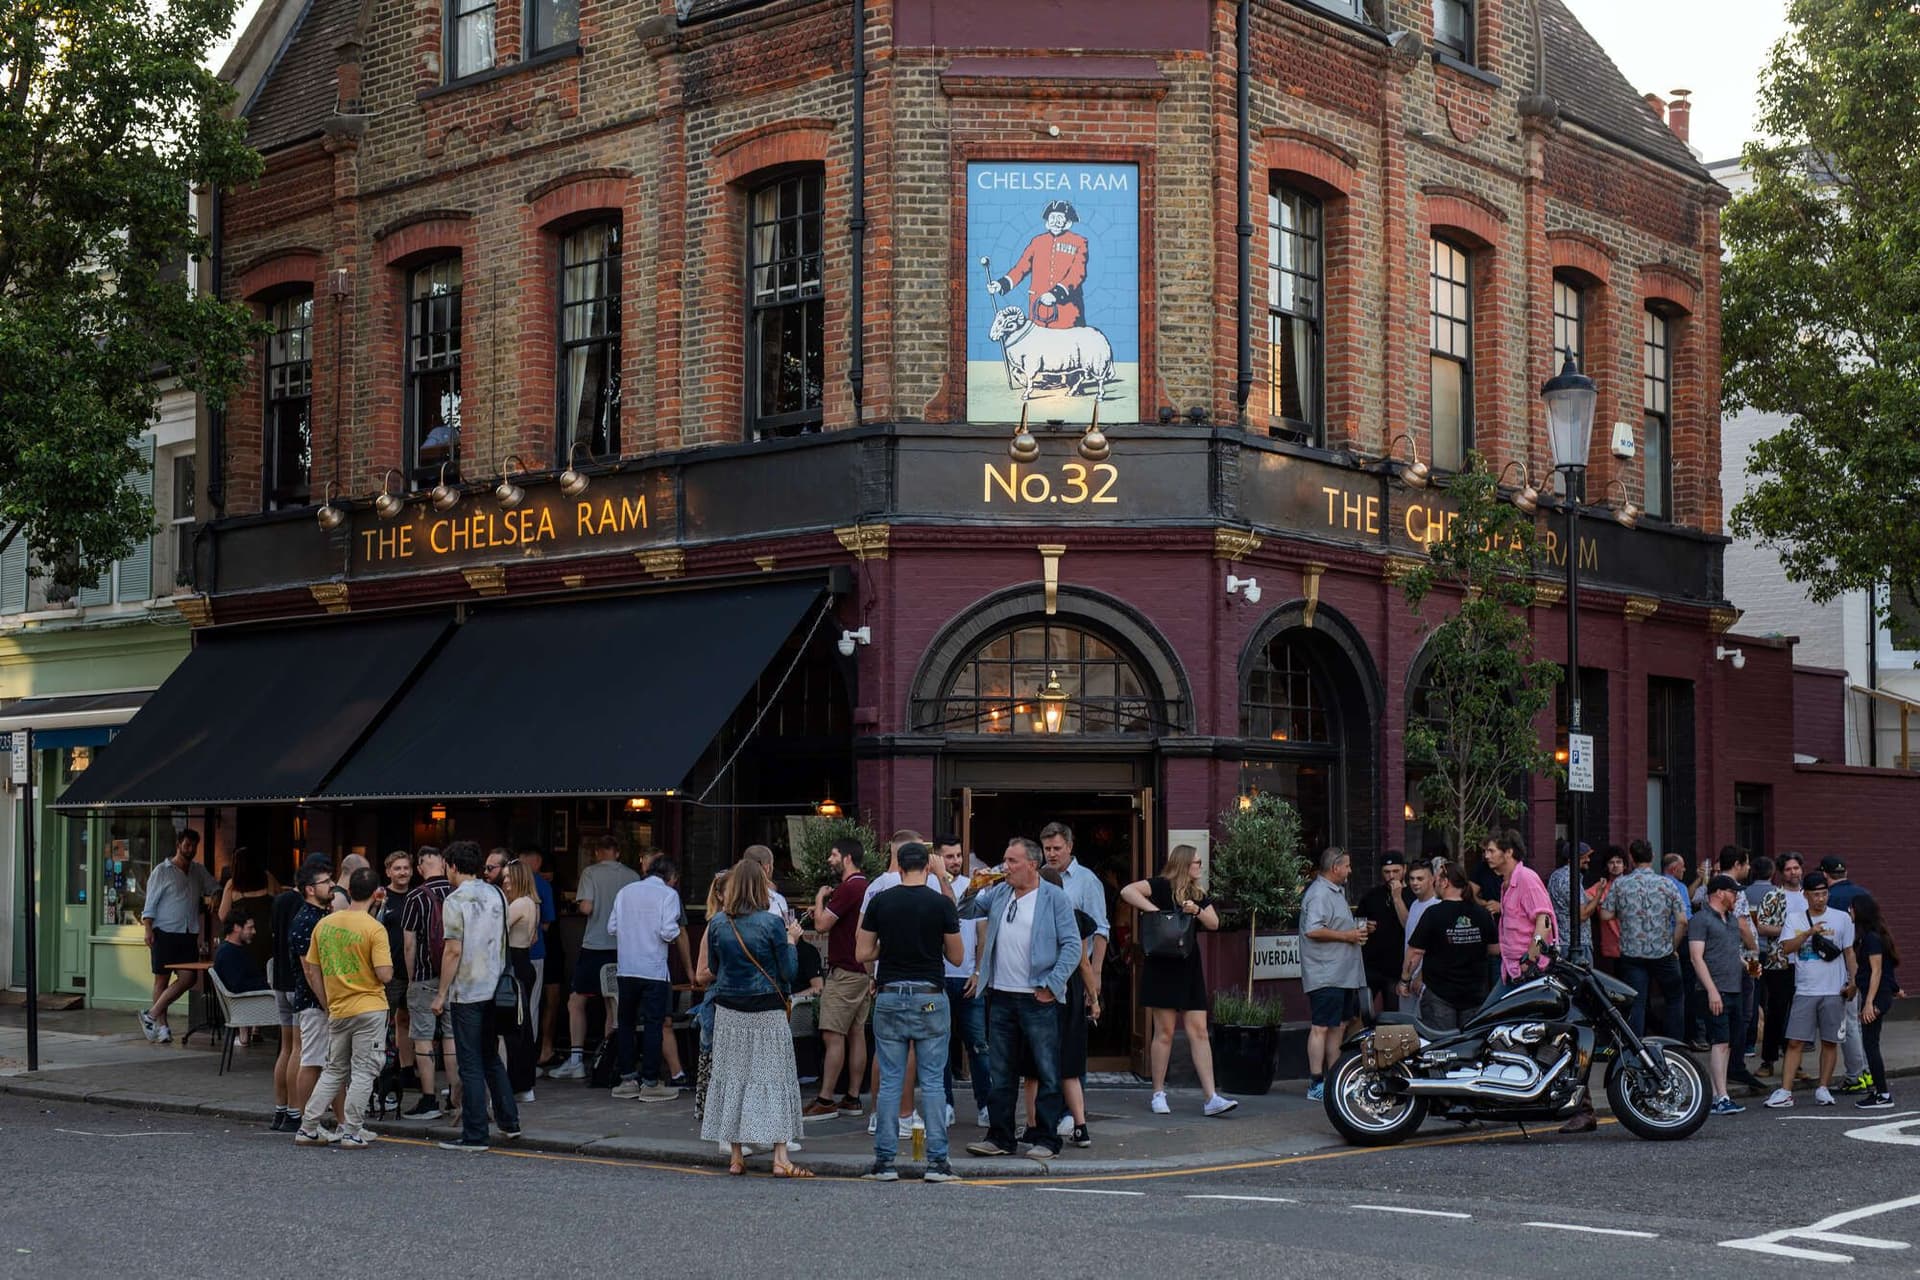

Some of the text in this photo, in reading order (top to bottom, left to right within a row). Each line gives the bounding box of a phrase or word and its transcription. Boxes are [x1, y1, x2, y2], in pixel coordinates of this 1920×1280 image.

[977, 171, 1128, 191] CHELSEA RAM
[984, 463, 1119, 504] No.32
[361, 494, 649, 561] THE CHELSEA RAM
[1322, 486, 1380, 535] THE
[1254, 950, 1300, 966] UVERDAL
